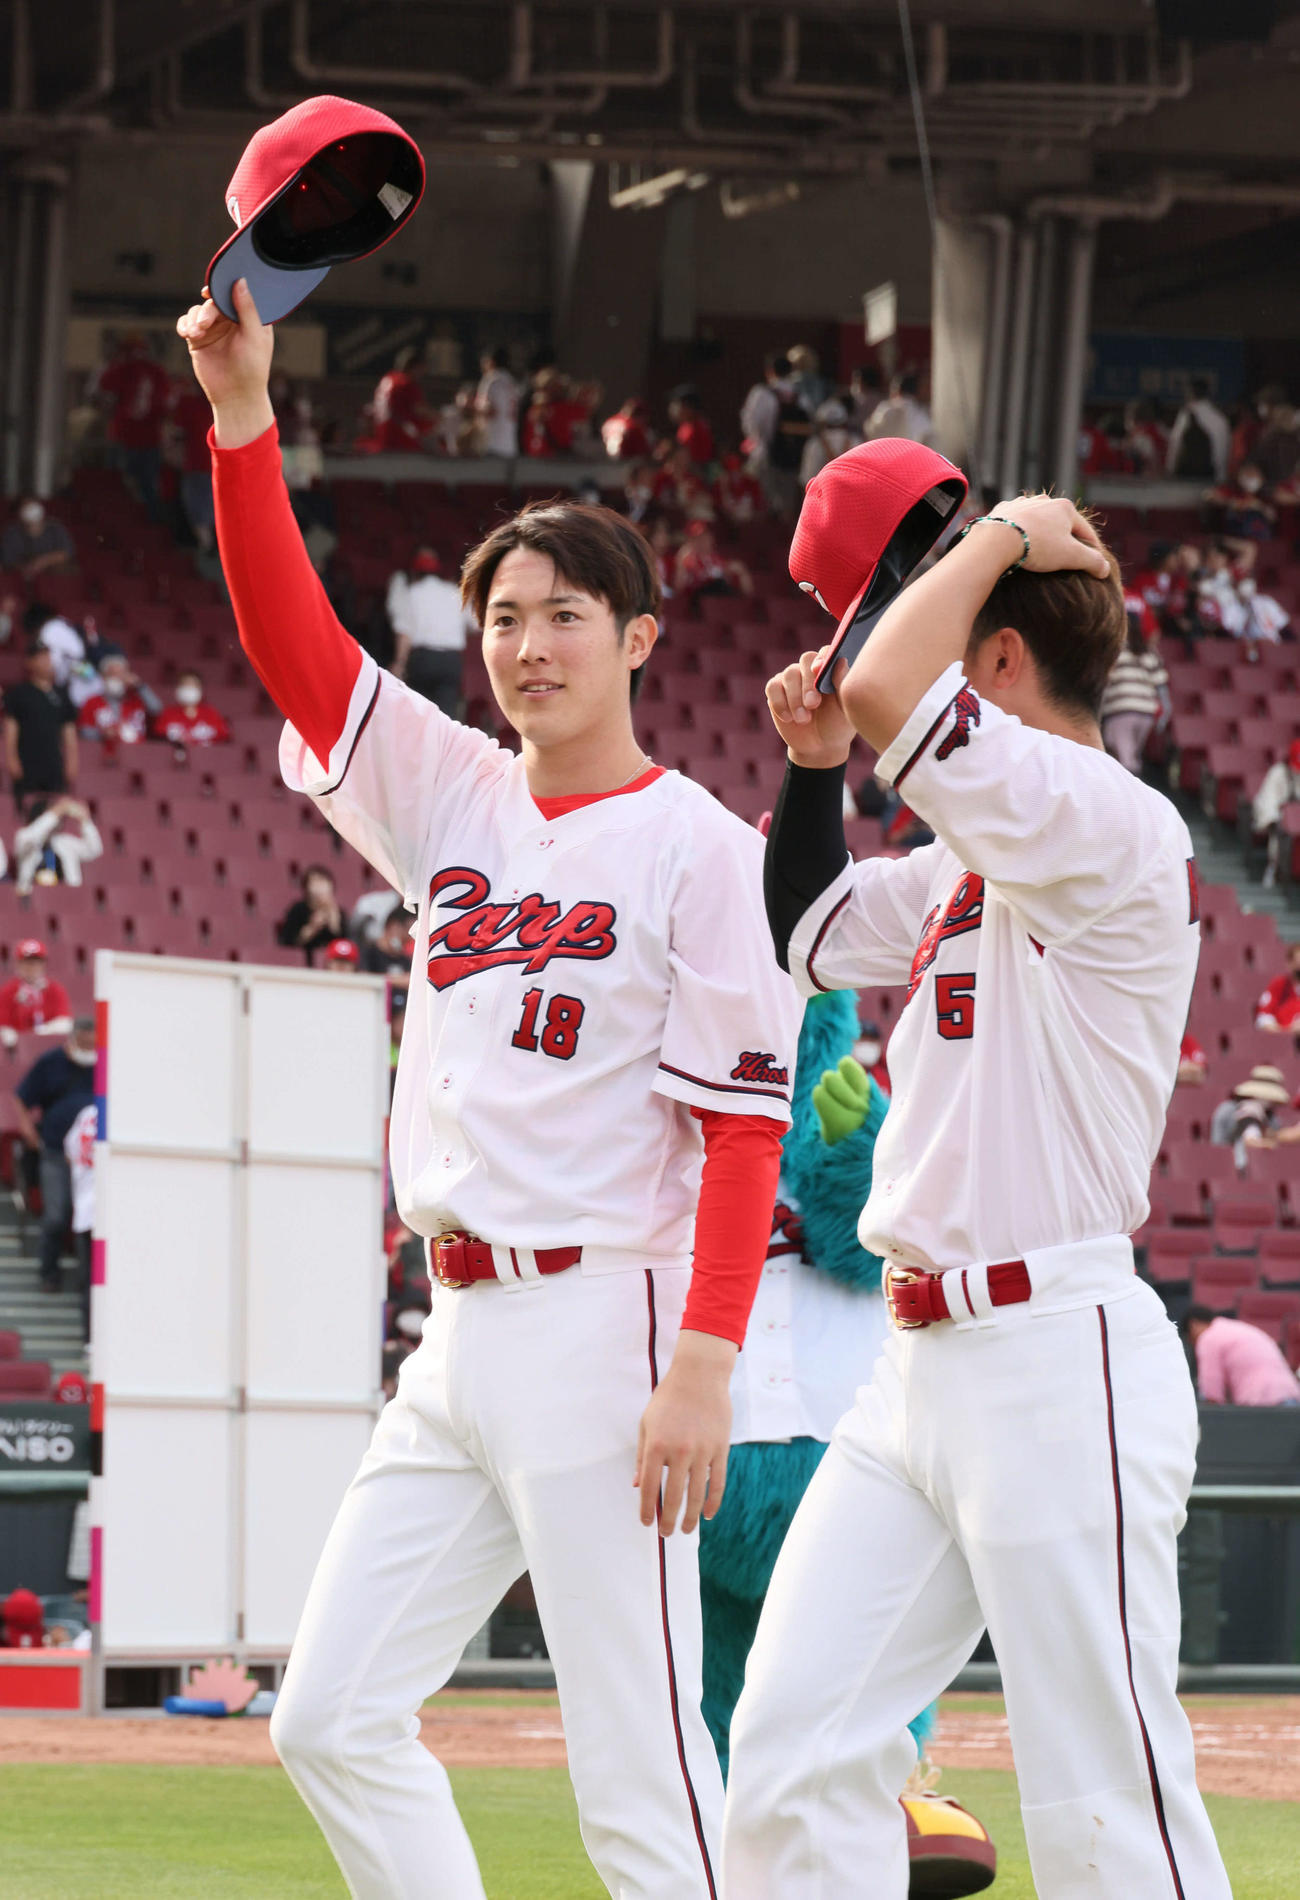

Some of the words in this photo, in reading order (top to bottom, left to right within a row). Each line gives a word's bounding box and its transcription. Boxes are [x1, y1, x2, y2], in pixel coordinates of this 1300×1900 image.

[427, 866, 617, 992] Carp
[511, 987, 585, 1060] 18
[935, 972, 976, 1040] 5
